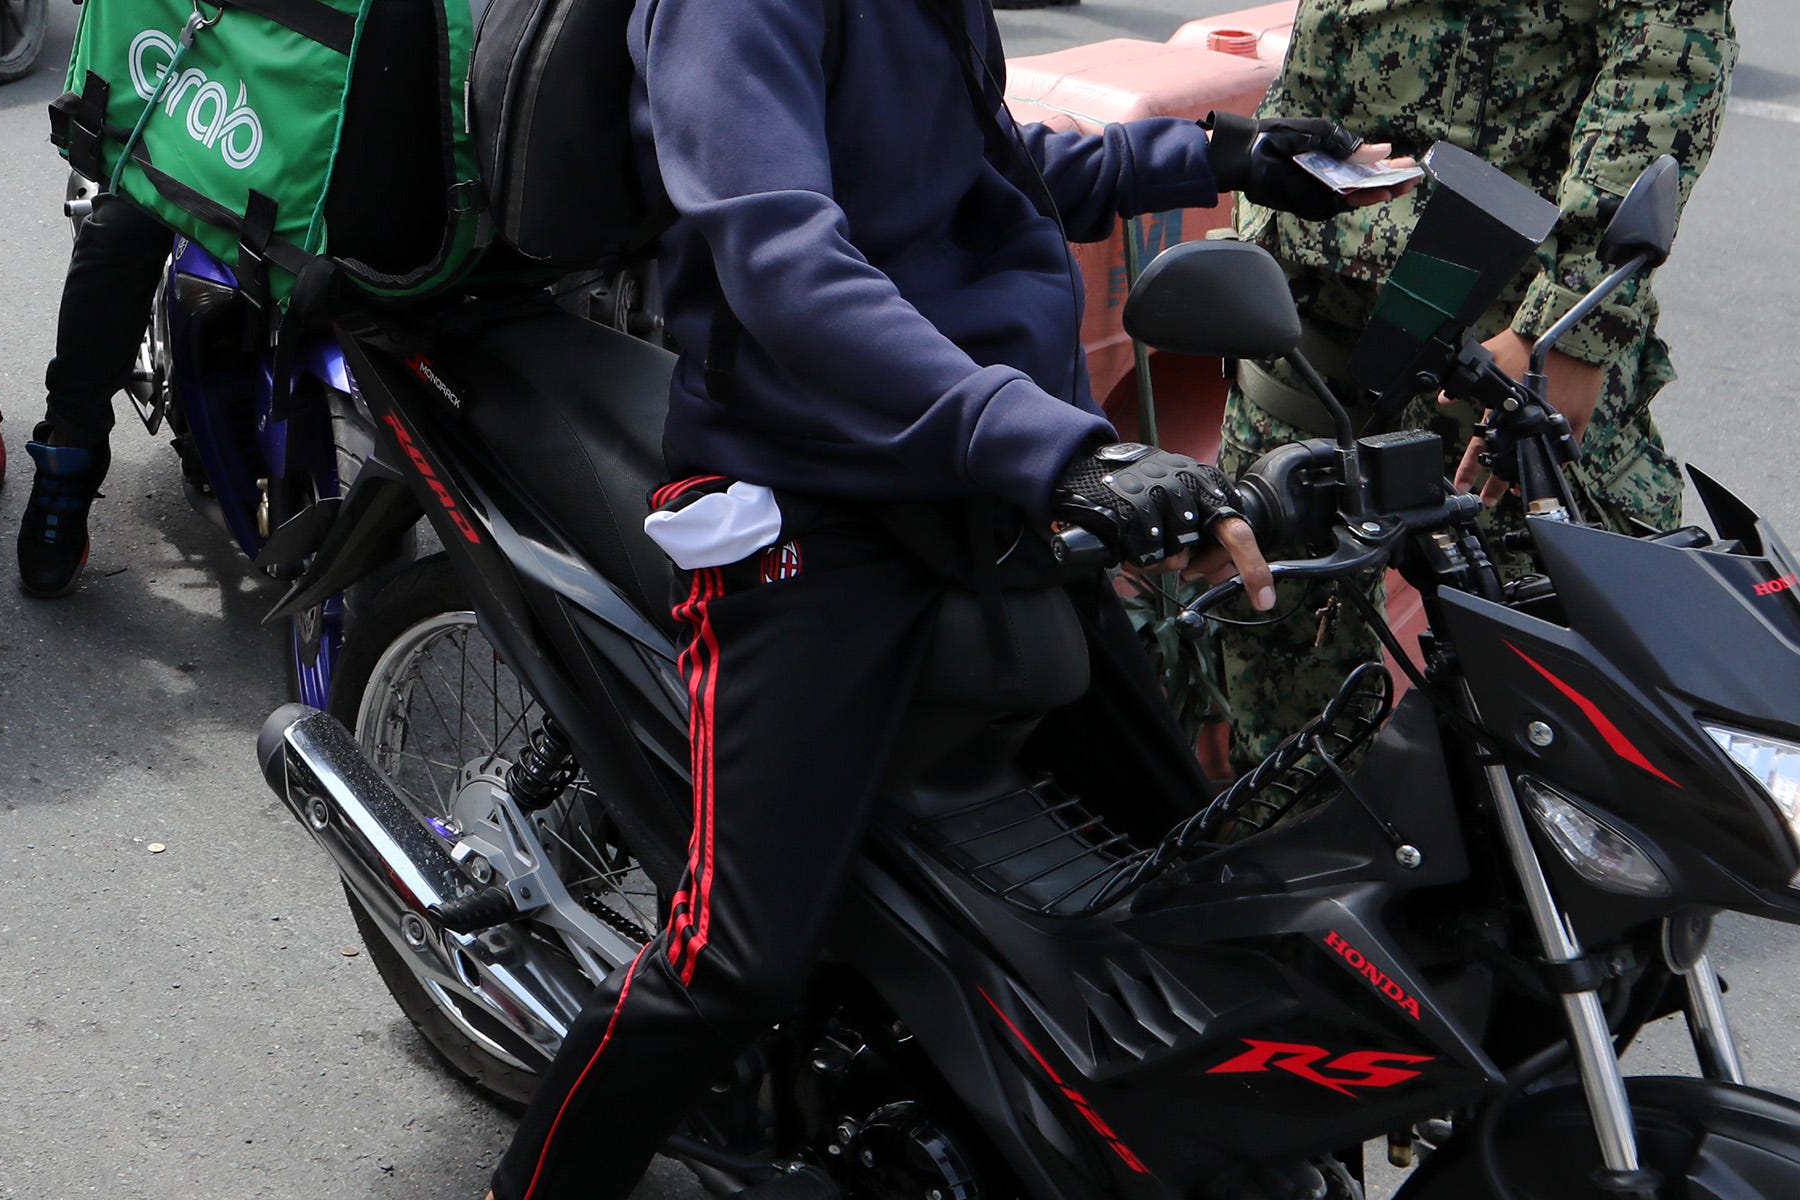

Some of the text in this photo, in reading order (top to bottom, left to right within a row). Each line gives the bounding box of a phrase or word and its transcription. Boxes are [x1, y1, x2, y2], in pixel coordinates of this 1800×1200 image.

[128, 29, 263, 170] Grab
[419, 361, 460, 409] MONORACK
[1323, 929, 1420, 1020] HONDA
[1205, 1038, 1436, 1099] RS
